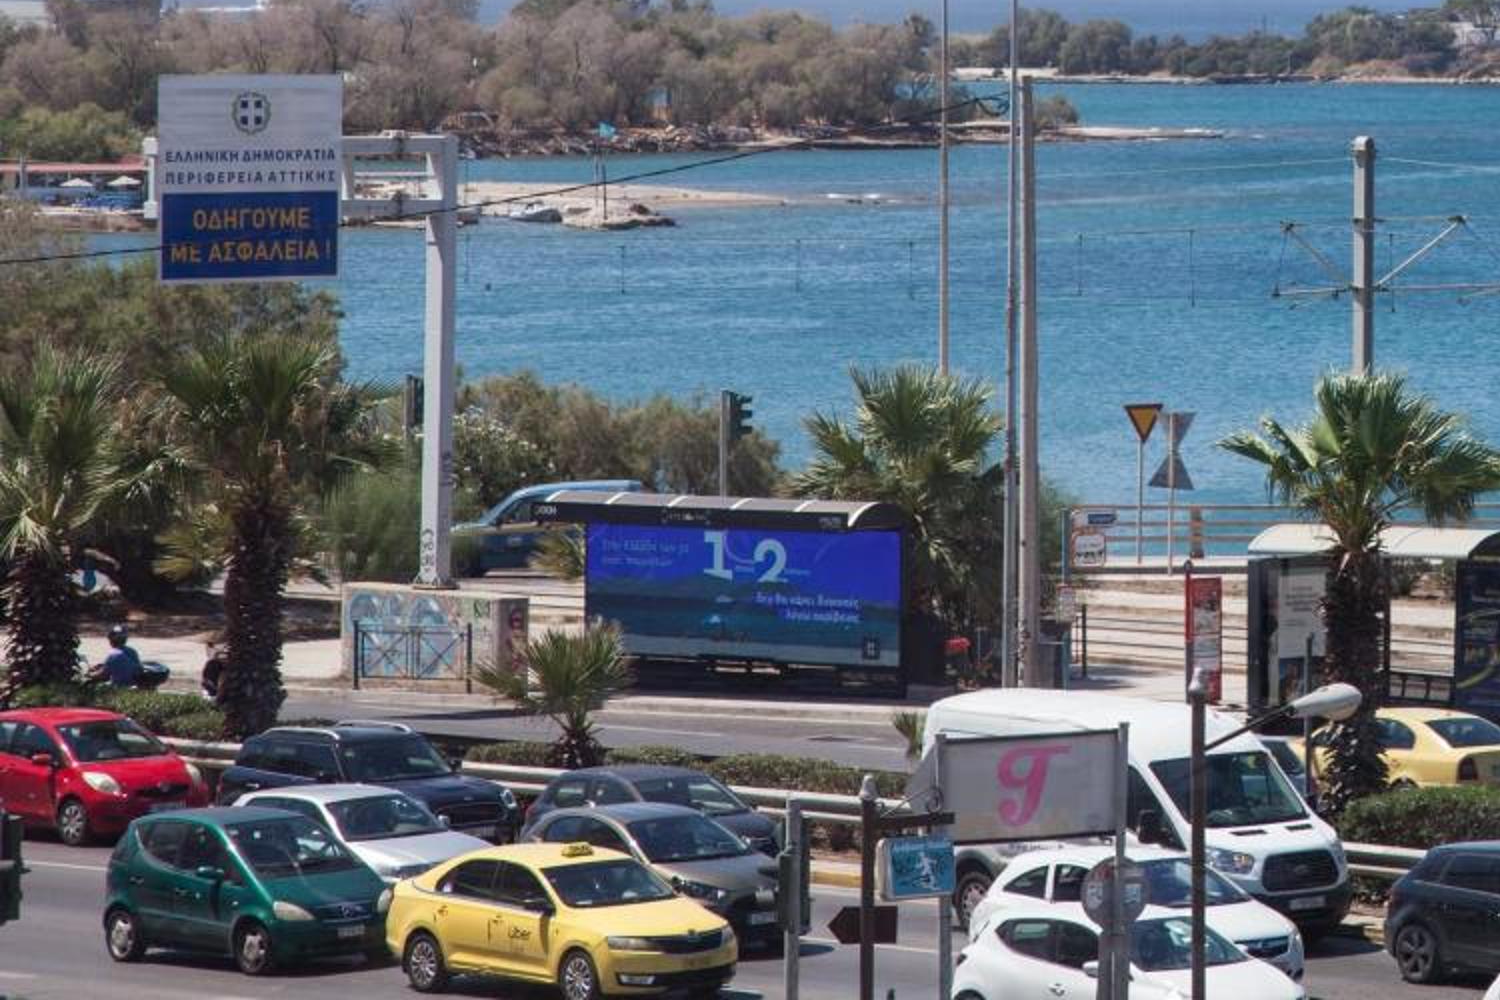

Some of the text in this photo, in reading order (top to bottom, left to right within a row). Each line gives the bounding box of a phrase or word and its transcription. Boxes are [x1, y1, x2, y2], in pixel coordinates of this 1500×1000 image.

[165, 149, 336, 163] ΕΛΛΗΝΙΚΗ ΔΗΜΟΚΡΑΤΙΑ
[165, 171, 336, 185] ΠΕΡΙΦΕΡΕΙΑ ΑΤΤΙΚΗΣ
[192, 207, 311, 231] ΟΔΗΓΟΥΜΕ
[171, 244, 202, 263] ΜΕ
[208, 239, 320, 263] ΑΣΦΑΛΕΙΑ
